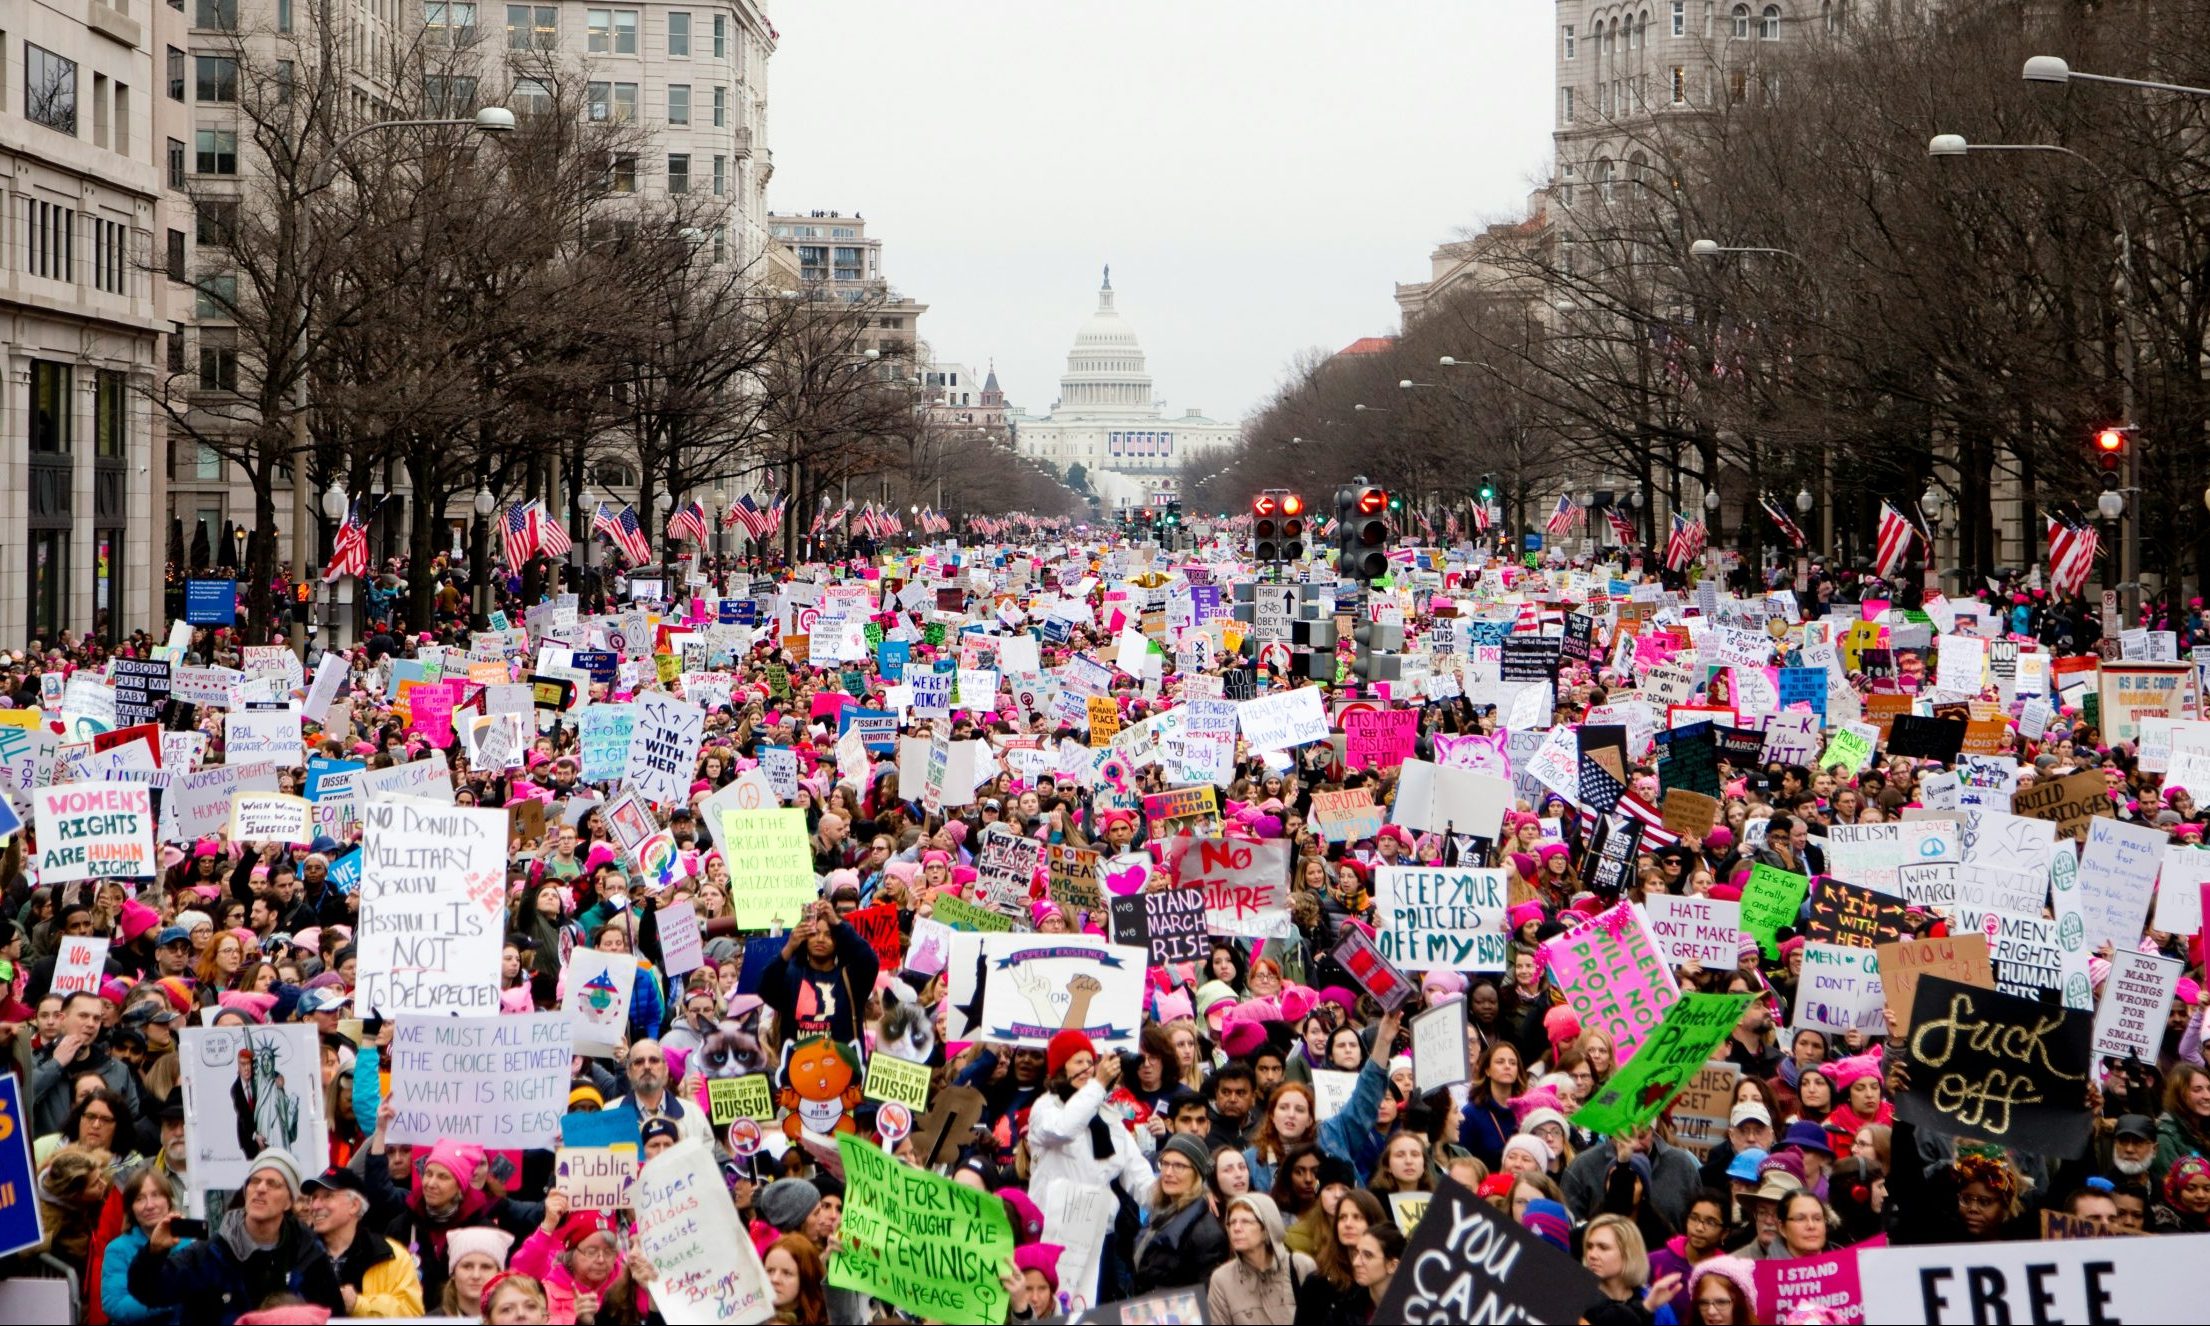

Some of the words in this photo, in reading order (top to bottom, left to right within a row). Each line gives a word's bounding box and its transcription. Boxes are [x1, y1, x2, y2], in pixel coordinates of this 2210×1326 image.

[1258, 588, 1278, 598] THRU
[1257, 617, 1278, 626] OBEY
[1432, 619, 1452, 629] BLACK
[1431, 630, 1454, 642] LIVES
[1565, 636, 1588, 648] OVARY
[244, 648, 283, 658] NASTY
[579, 654, 593, 662] SAY
[594, 654, 607, 662] NO
[1563, 645, 1588, 656] ACTION
[1720, 650, 1764, 668] TREASON
[1991, 641, 2018, 662] NO!
[116, 661, 167, 673] NOBODY
[244, 659, 286, 670] WOMEN
[116, 676, 144, 688] PUTS
[150, 678, 170, 690] MY
[176, 672, 194, 681] LOVE
[2119, 677, 2130, 689] AS
[2153, 677, 2178, 690] COME
[116, 690, 146, 702] BABY
[1660, 683, 1673, 693] ON
[116, 704, 156, 717] MAKER
[1373, 712, 1390, 726] MY
[1392, 710, 1418, 726] BODY
[1093, 715, 1115, 724] PLACE
[656, 728, 679, 744] I'M
[1294, 719, 1326, 739] RIGHT
[1346, 736, 1410, 752] LEGISLATION
[1725, 740, 1760, 751] MARCH
[1775, 734, 1795, 744] this
[645, 738, 685, 762] WITH
[1187, 744, 1211, 767] Body
[236, 762, 276, 778] RIGHTS
[646, 754, 676, 775] HER
[771, 770, 791, 778] WITH
[773, 776, 788, 784] HER
[47, 789, 148, 815] WOMEN'S
[1156, 790, 1202, 806] UNITED
[1312, 792, 1373, 812] DISPUTIN
[2015, 783, 2064, 814] BUILD
[312, 804, 359, 823] EQUAL
[1173, 800, 1213, 816] STAND
[2037, 792, 2112, 822] BRIDGES
[58, 814, 138, 840] RIGHTS
[736, 818, 754, 830] ON
[760, 817, 787, 830] THE
[728, 836, 771, 850] BRIGHT
[778, 835, 804, 848] SIDE
[1831, 825, 1898, 843] RACISM
[2093, 825, 2115, 843] We
[2120, 838, 2154, 856] march
[44, 846, 86, 869] ARE
[88, 844, 144, 860] HUMAN
[364, 835, 472, 871] MILITARY
[1053, 846, 1096, 864] DON'T
[1604, 843, 1627, 856] LOVE
[88, 859, 140, 876] RIGHTS
[740, 856, 760, 870] NO
[766, 855, 800, 868] MORE
[1599, 858, 1622, 872] NO
[734, 876, 780, 890] GRIZZLY
[1596, 871, 1618, 885] HATE
[1759, 870, 1778, 883] It's
[1781, 876, 1797, 890] fun
[1905, 868, 1939, 882] WHY
[1392, 872, 1445, 907] KEEP
[1450, 874, 1503, 908] YOUR
[1765, 891, 1786, 904] rally
[1051, 890, 1099, 908] SCHOOLS
[1115, 901, 1134, 913] we
[1144, 890, 1203, 915] STAND
[1752, 902, 1769, 911] and
[940, 903, 975, 923] CANNOT
[947, 896, 964, 910] OUR
[968, 907, 1009, 925] CLIMATE
[1394, 904, 1482, 930] POLICIES
[1670, 902, 1710, 920] HATE
[361, 906, 439, 938] ASSAULT
[446, 902, 484, 936] IS
[1146, 910, 1207, 937] MARCH
[1838, 915, 1879, 934] WITH
[1119, 926, 1136, 938] we
[1152, 934, 1210, 960] RISE
[1696, 926, 1737, 943] MAKE
[69, 945, 91, 966] We
[392, 937, 454, 970] NOT
[1013, 951, 1050, 961] RESPECT
[1056, 950, 1105, 960] EXISTENCE
[1380, 930, 1420, 962] OFF
[1426, 933, 1474, 965] MY
[1672, 943, 1726, 961] GREAT!
[2135, 959, 2157, 971] TOO
[56, 969, 97, 992] won't
[1816, 975, 1856, 991] DON'T
[2124, 969, 2163, 984] MANY
[1572, 941, 1636, 1048] PROTECT
[2118, 981, 2163, 997] THINGS
[1051, 993, 1069, 1003] OR
[2116, 993, 2159, 1009] WRONG
[2122, 1006, 2145, 1018] FOR
[1012, 1026, 1050, 1037] EXPECT
[2119, 1019, 2144, 1031] ONE
[396, 1025, 426, 1044] WE
[435, 1026, 484, 1046] MUST
[492, 1025, 522, 1044] ALL
[531, 1022, 571, 1042] FACE
[2107, 1028, 2149, 1044] SMALL
[400, 1051, 434, 1072] THE
[442, 1053, 497, 1073] CHOICE
[504, 1048, 570, 1072] BETWEEN
[404, 1081, 464, 1103] WHAT
[474, 1081, 496, 1102] IS
[502, 1076, 559, 1102] RIGHT
[868, 1075, 924, 1106] PUSSY!
[714, 1097, 769, 1120] PUSSY!
[1678, 1092, 1711, 1110] GET
[391, 1112, 431, 1134] AND
[436, 1114, 481, 1134] WHAT
[494, 1114, 514, 1134] IS
[521, 1111, 564, 1132] EASY
[571, 1155, 630, 1177] Public
[640, 1172, 696, 1210] Super
[905, 1178, 946, 1210] FOR
[950, 1186, 983, 1218] MY
[905, 1210, 952, 1237] TAUGHT
[965, 1222, 998, 1244] ME
[1446, 1200, 1521, 1283] YOU
[884, 1226, 1001, 1285] FEMINISM
[835, 1250, 879, 1282] REST
[1787, 1262, 1838, 1280] STAND
[1777, 1280, 1822, 1297] WITH
[1919, 1261, 2121, 1326] FREE
